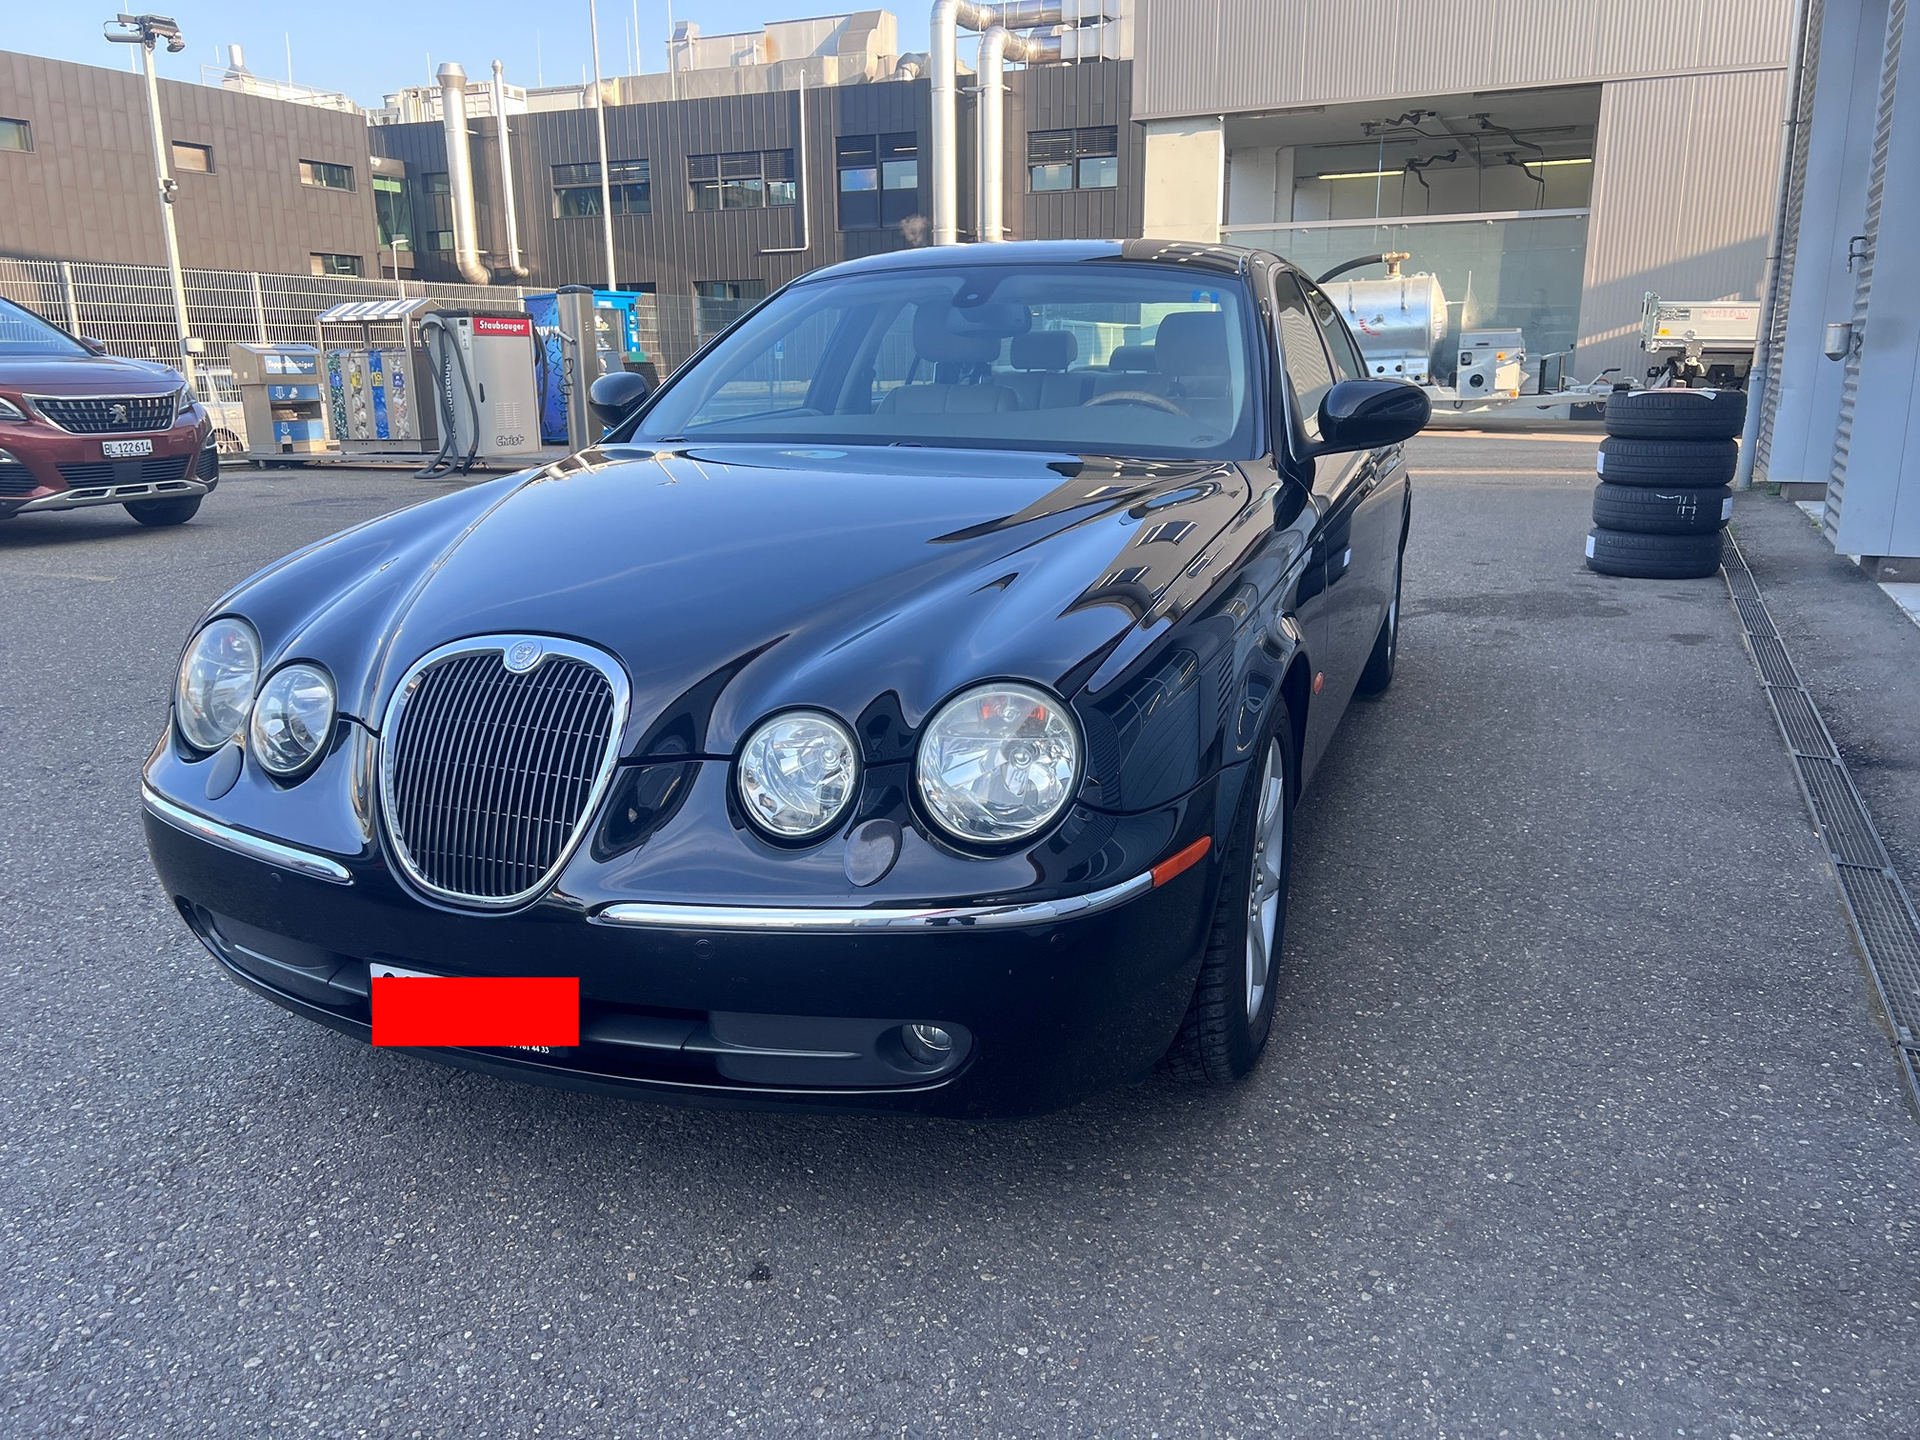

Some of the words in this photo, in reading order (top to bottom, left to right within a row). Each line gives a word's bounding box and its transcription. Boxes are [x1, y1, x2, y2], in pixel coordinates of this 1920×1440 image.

[479, 320, 525, 332] Staubsauger
[496, 434, 525, 447] Christ
[541, 1046, 549, 1054] 33
